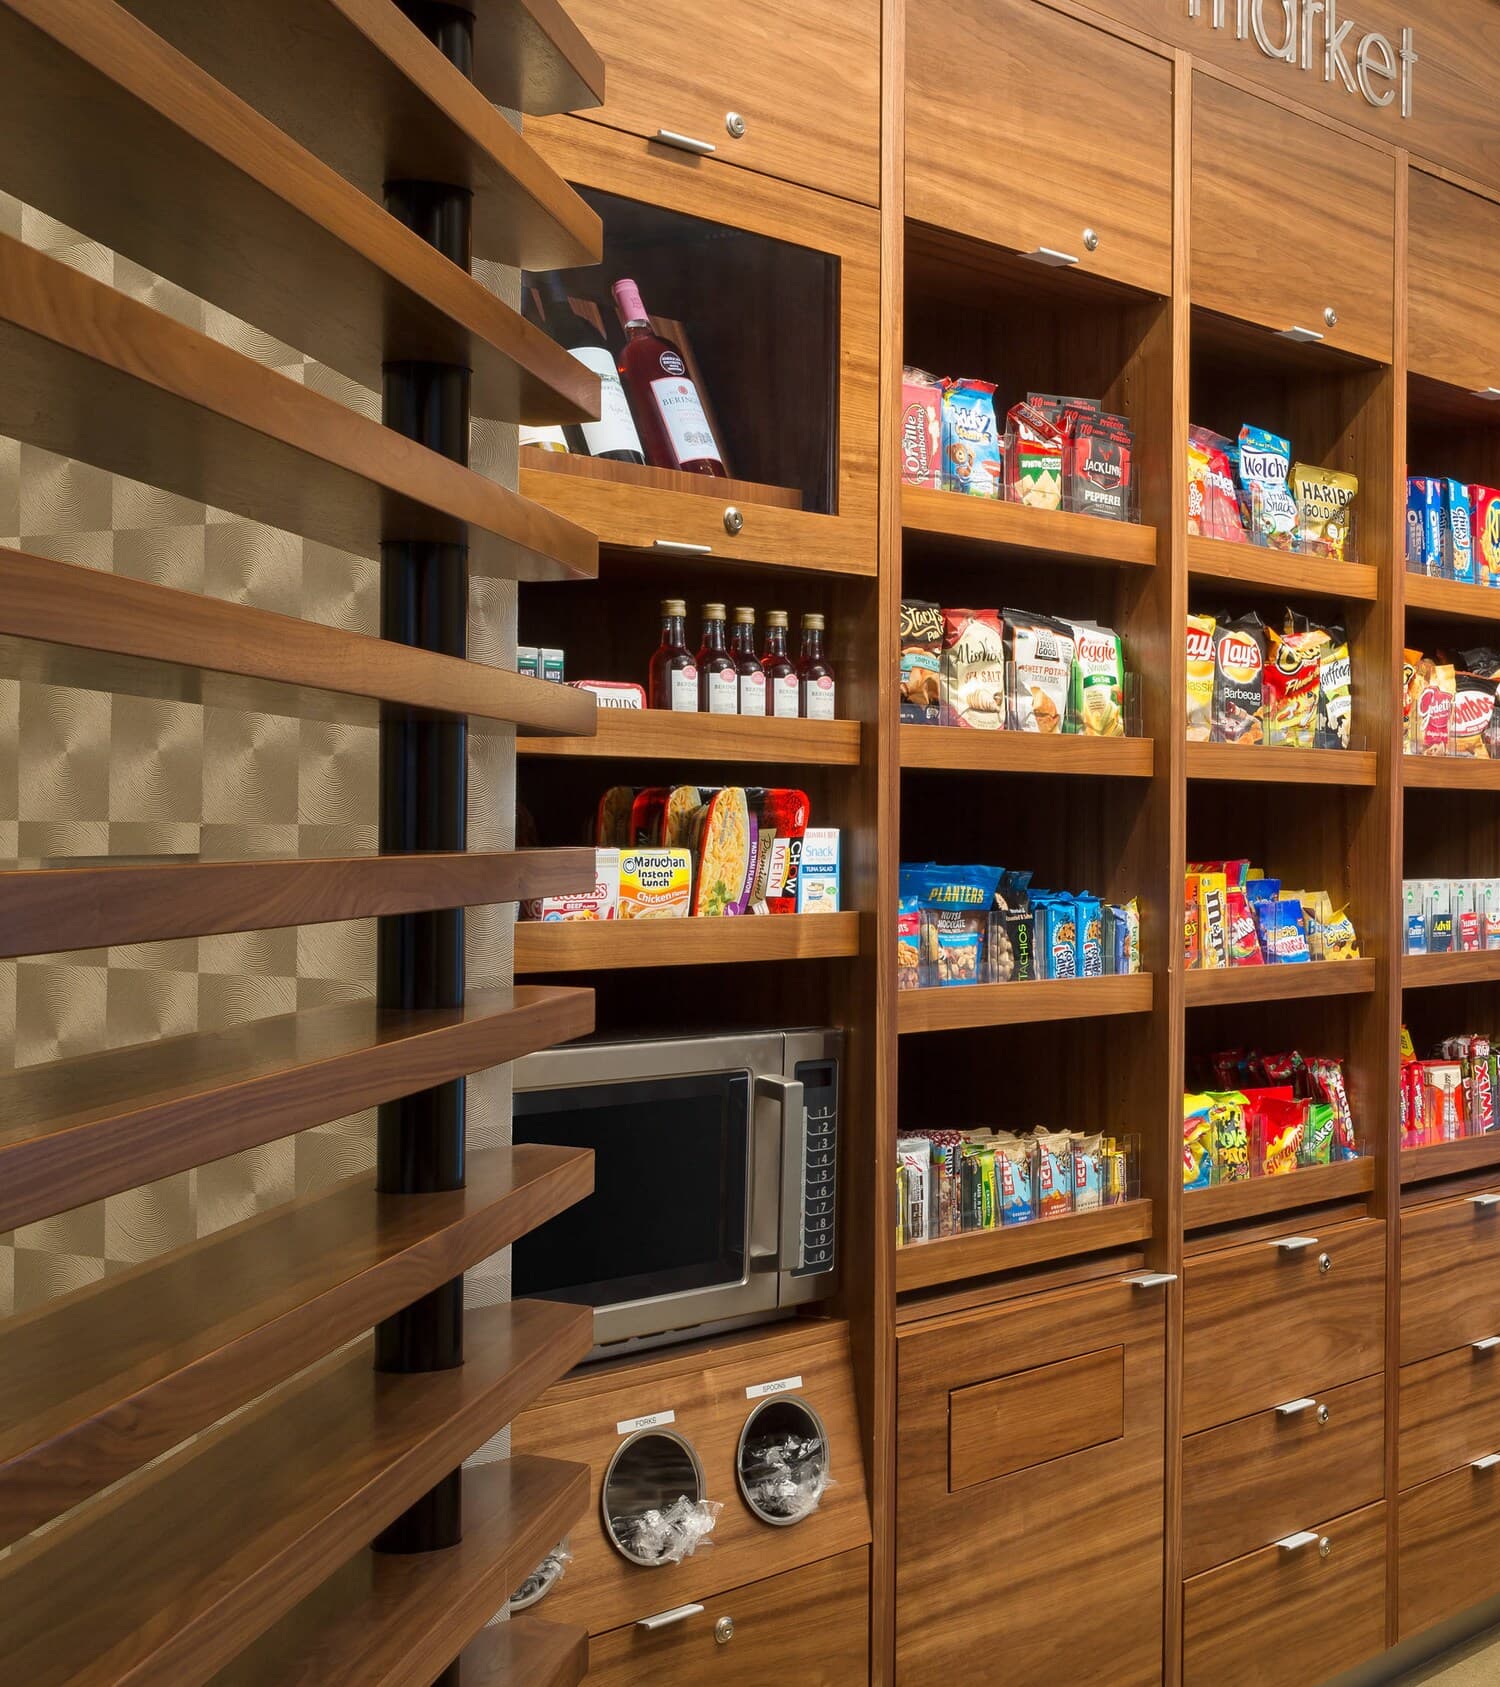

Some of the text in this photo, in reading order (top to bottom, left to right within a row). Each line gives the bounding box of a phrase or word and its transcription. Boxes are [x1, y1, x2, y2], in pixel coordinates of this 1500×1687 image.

[1083, 458, 1104, 472] JACK
[1038, 648, 1057, 657] GOOD
[1074, 636, 1116, 663] Veggie
[980, 670, 1002, 683] SALT
[1224, 687, 1261, 701] Barbecue
[805, 844, 834, 858] Snack
[634, 856, 686, 869] Maruchan
[769, 844, 786, 890] MEIN
[784, 840, 802, 894] CHOW
[638, 869, 674, 879] Instant
[641, 878, 670, 888] Lunch
[636, 890, 672, 905] Chicken
[927, 885, 985, 905] PLANTERS
[1433, 919, 1452, 932] Advil
[1017, 923, 1029, 979] TACHIOS
[1474, 1060, 1495, 1135] TWIX
[945, 1144, 954, 1177] KIND
[762, 1381, 787, 1393] SPOONS
[635, 1416, 657, 1428] FORKS
